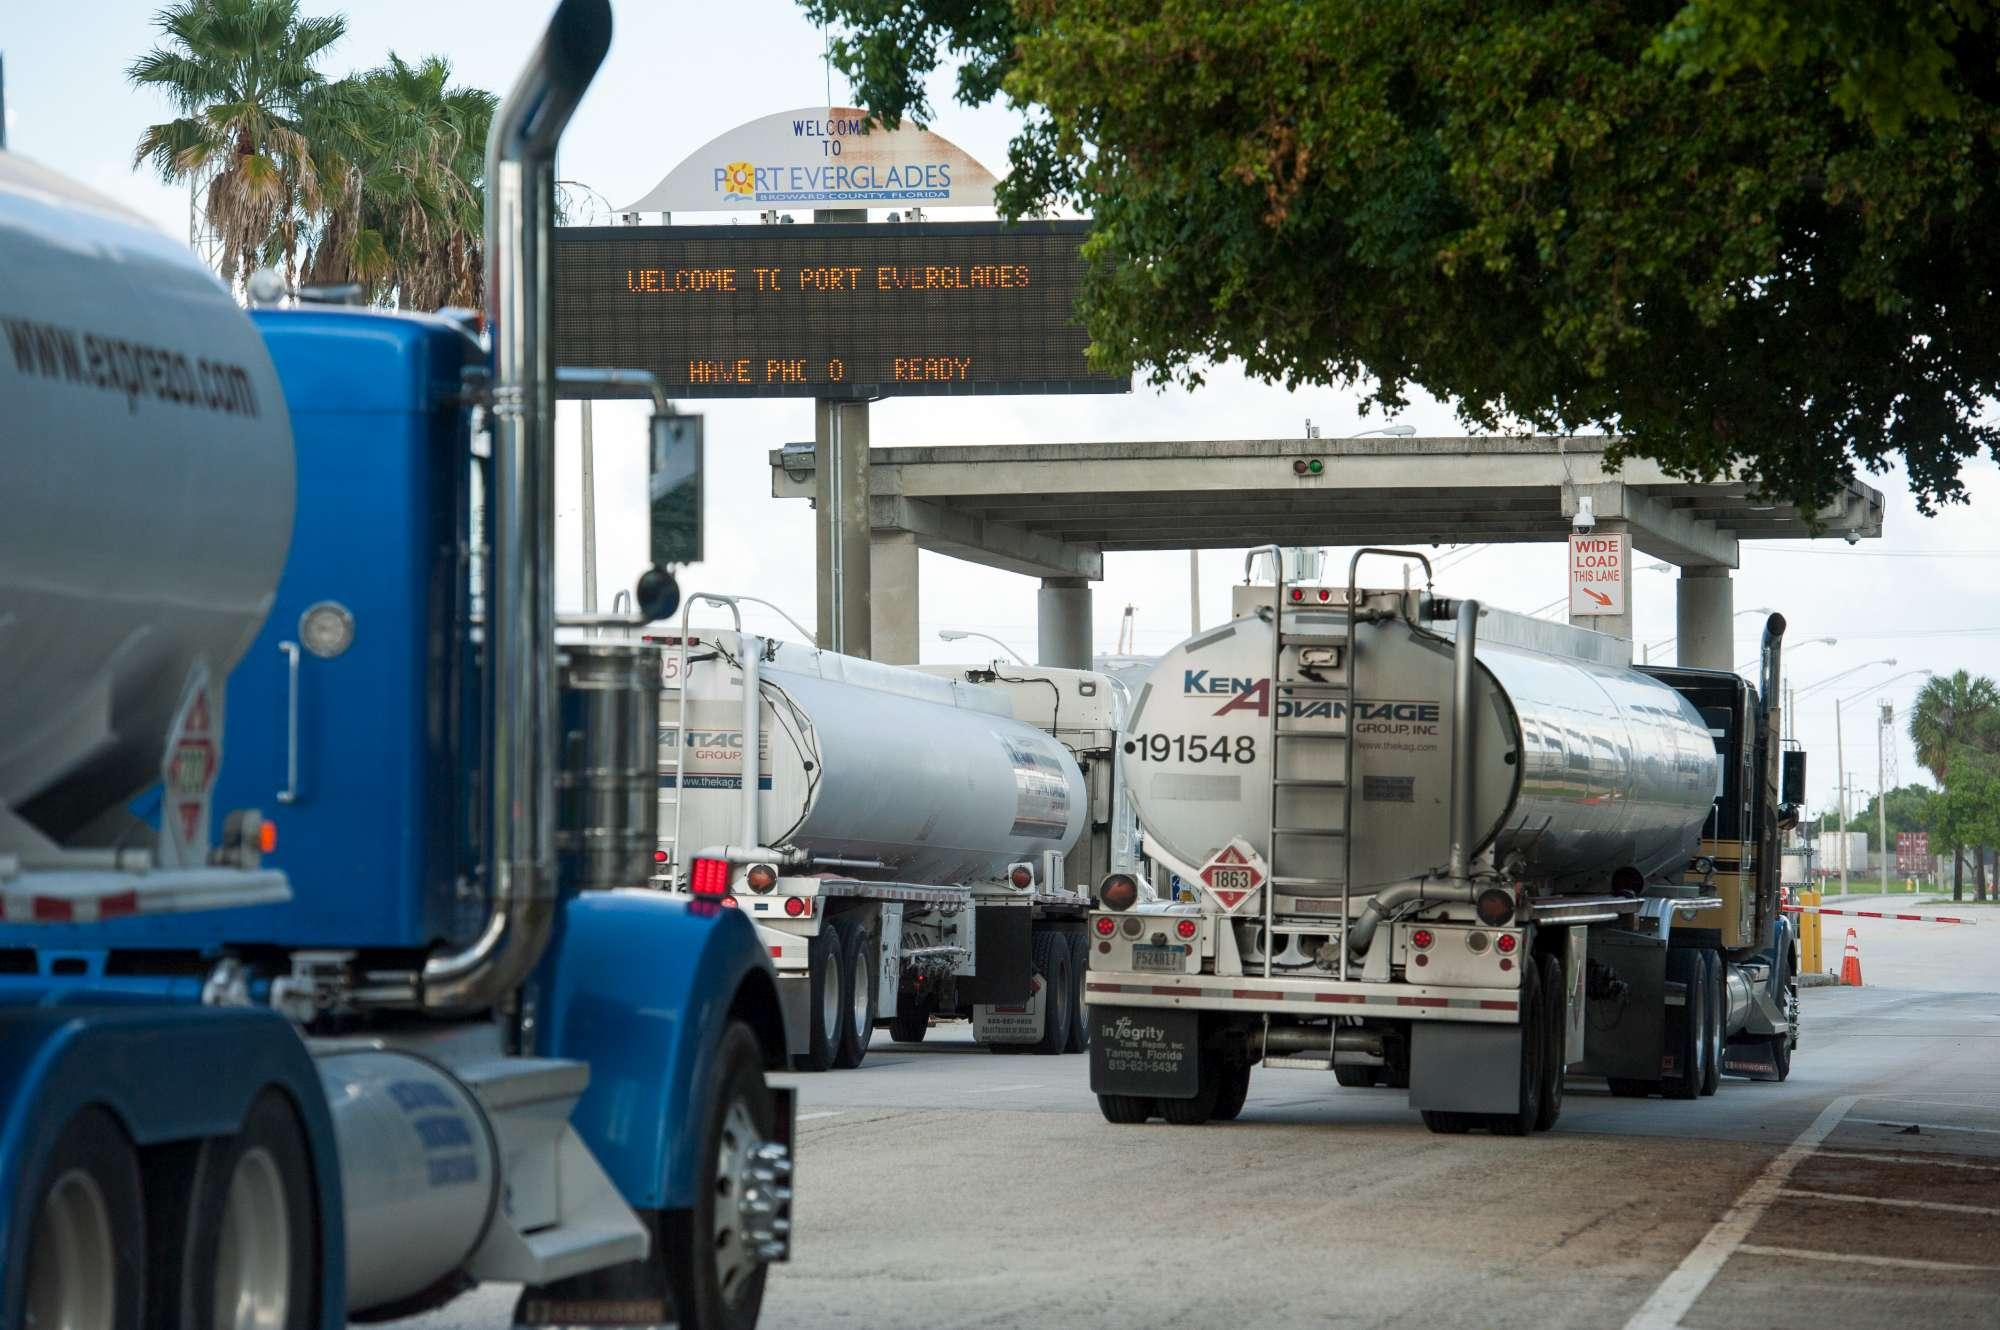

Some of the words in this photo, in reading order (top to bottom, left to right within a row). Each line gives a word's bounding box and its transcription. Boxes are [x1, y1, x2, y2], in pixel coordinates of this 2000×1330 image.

[822, 140, 842, 157] TO
[790, 163, 951, 192] EVERGLADES
[759, 192, 826, 201] BROWARD
[891, 191, 948, 199] FLORIDA
[627, 269, 737, 293] WELCOME
[800, 267, 863, 290] PORT
[689, 360, 752, 383] HAVE
[895, 357, 973, 382] READY
[1575, 540, 1619, 553] WIDE
[1576, 555, 1618, 568] LOAD
[1574, 570, 1594, 583] THIS
[1596, 570, 1621, 582] LANE
[1136, 733, 1256, 764] 191548
[1359, 742, 1438, 752] www.thekag.com
[1213, 870, 1249, 888] 1863
[1147, 1049, 1183, 1061] Florida
